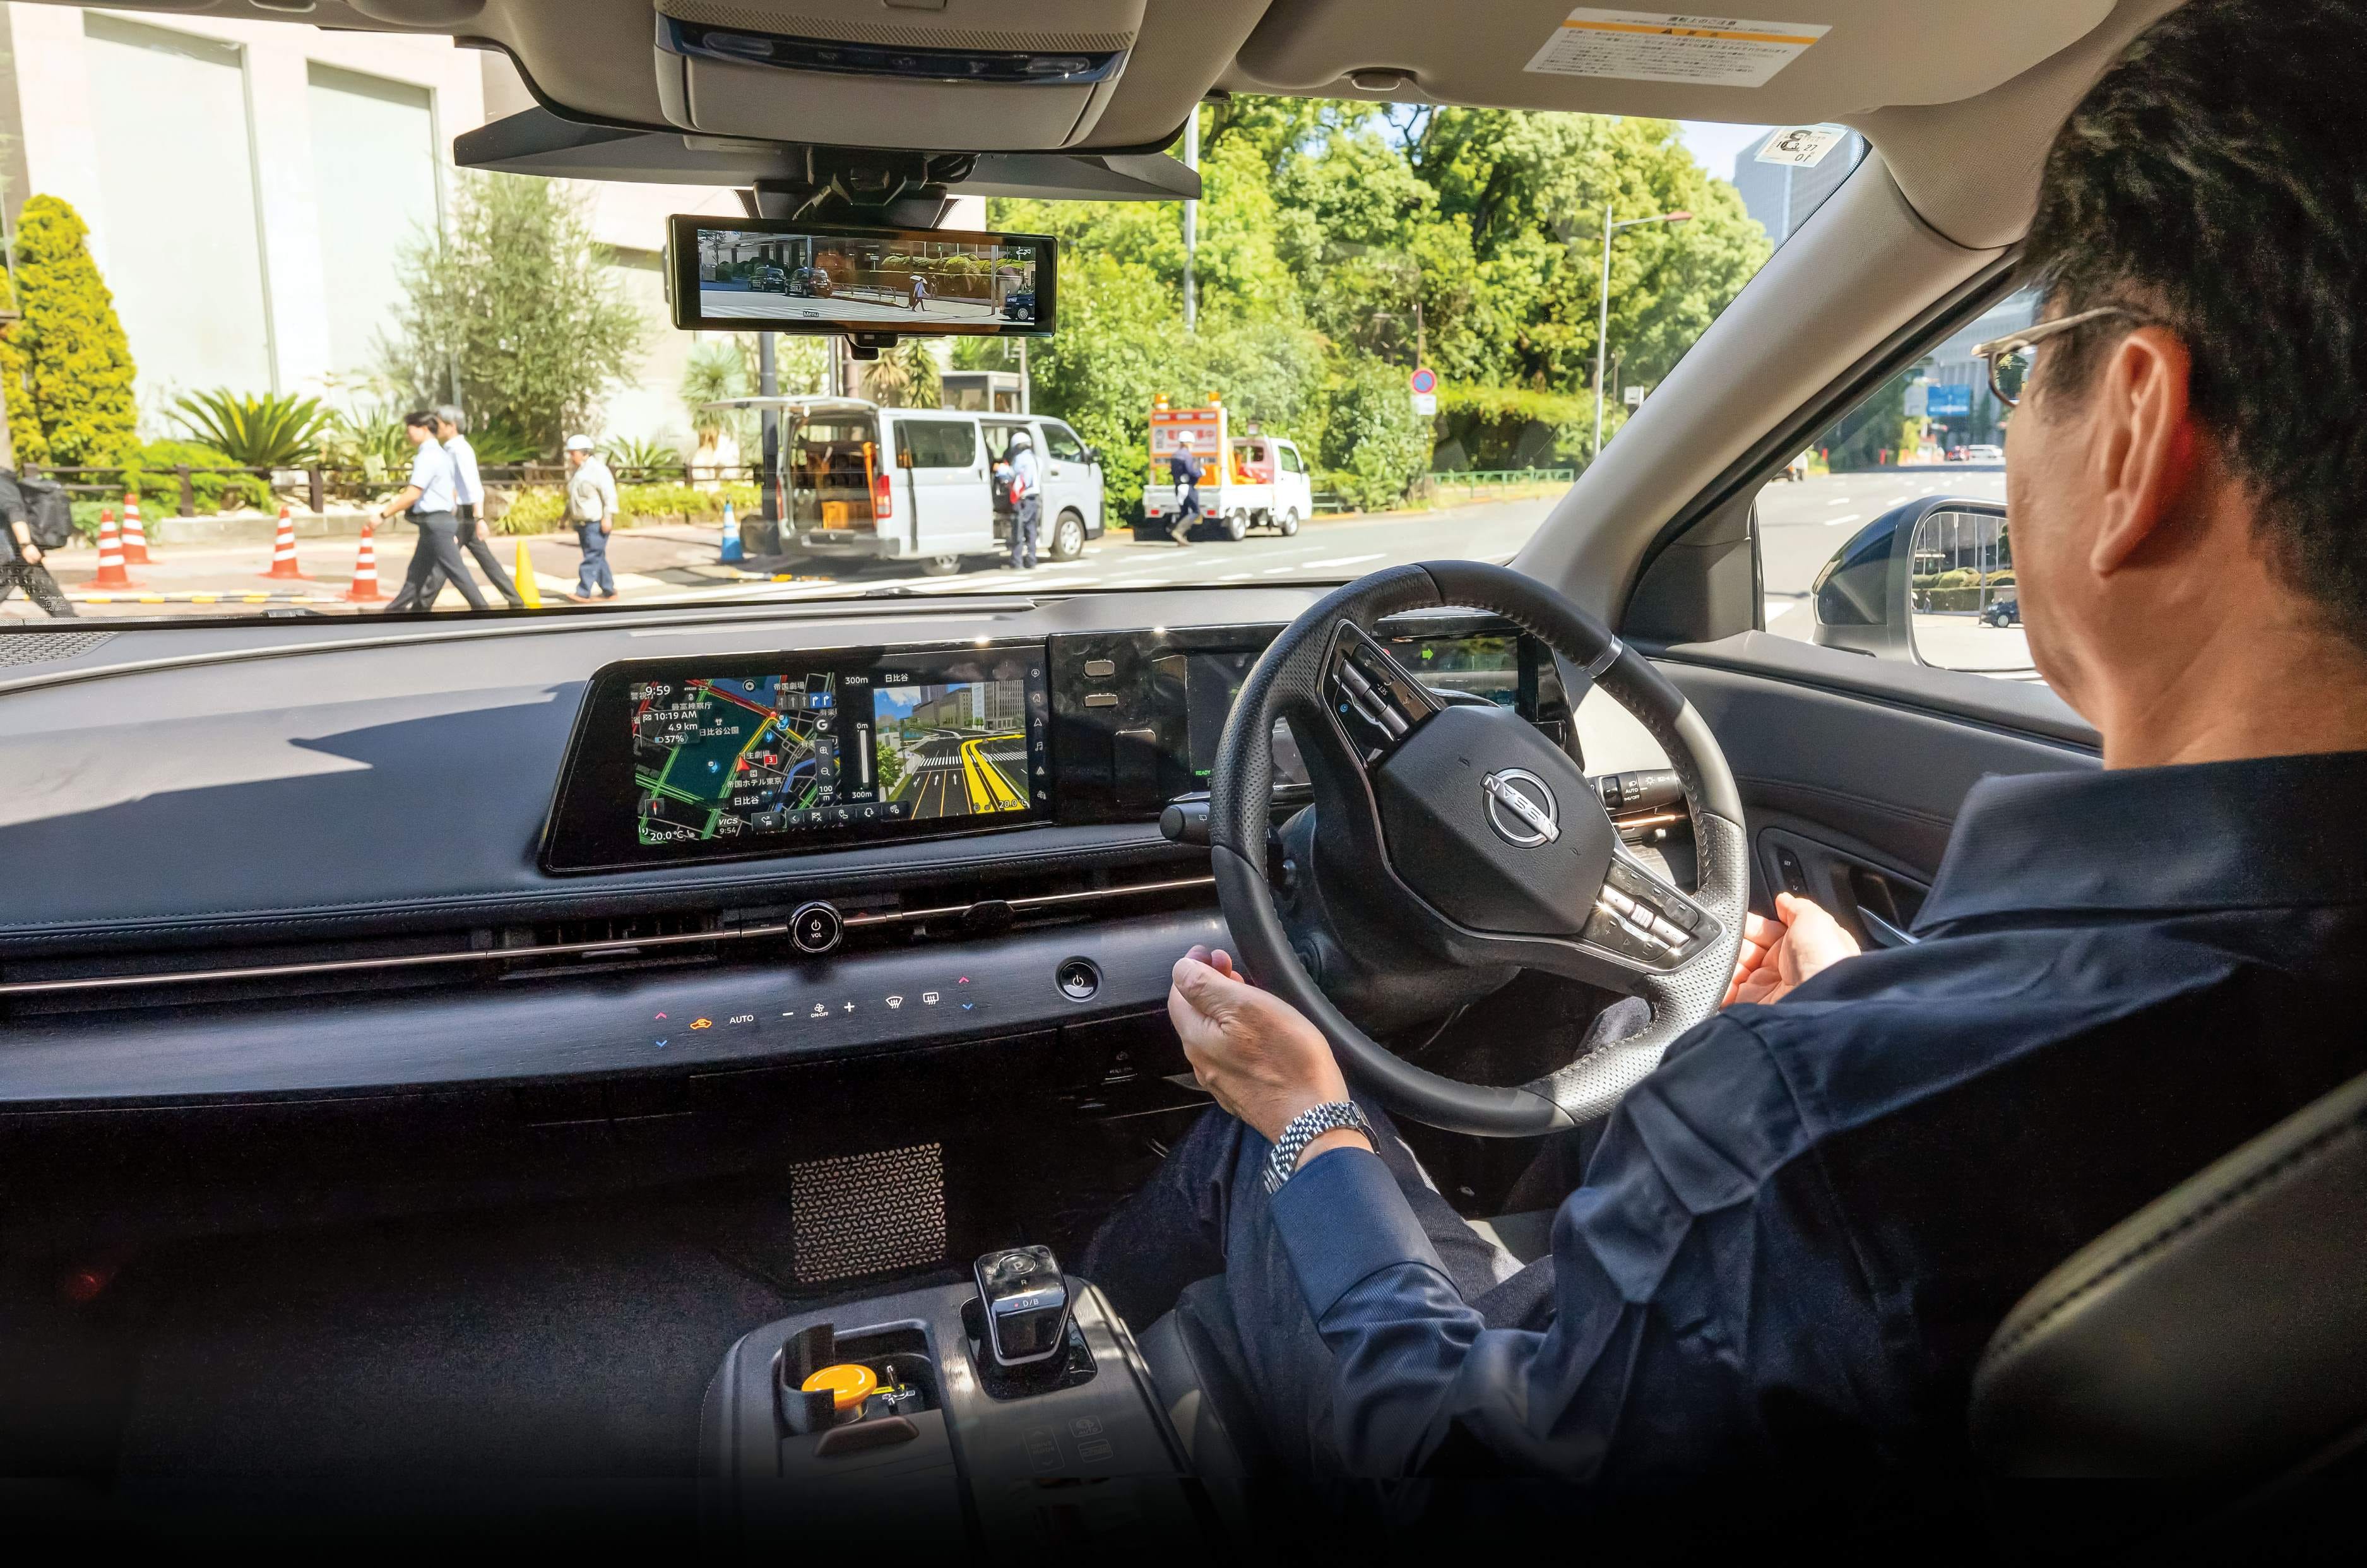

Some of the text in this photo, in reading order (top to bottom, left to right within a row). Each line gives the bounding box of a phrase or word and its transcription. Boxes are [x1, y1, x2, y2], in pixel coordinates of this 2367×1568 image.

[845, 676, 868, 684] 300m
[885, 674, 908, 682] 日比谷
[646, 686, 670, 696] 9:59
[773, 682, 805, 691] 帝国劇場
[655, 711, 697, 720] 10:19 AM
[699, 727, 739, 736] 日比谷公園
[727, 777, 783, 788] 帝国ホテル東京
[735, 796, 759, 805] 日比谷
[999, 800, 1017, 808] 20.0
[650, 831, 672, 841] 20.0
[730, 1015, 754, 1024] AUTO
[1013, 1261, 1023, 1271] P
[1023, 1298, 1039, 1307] D/B
